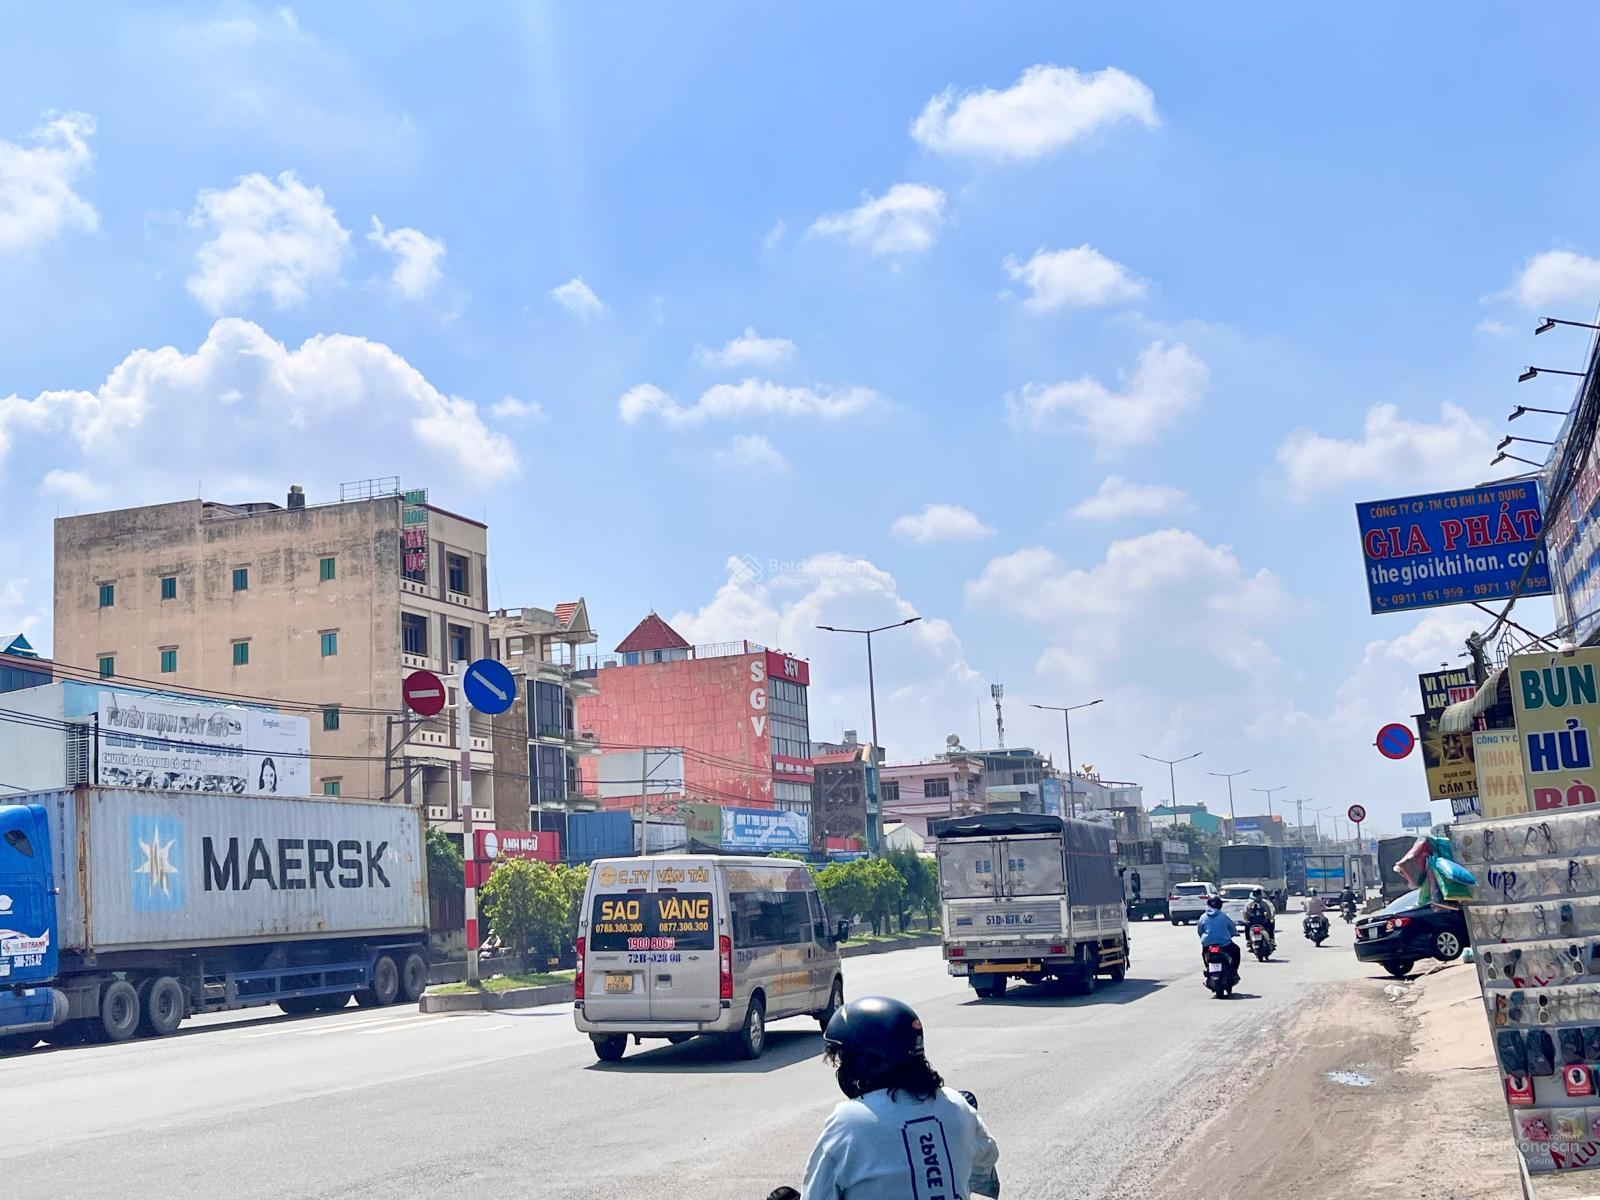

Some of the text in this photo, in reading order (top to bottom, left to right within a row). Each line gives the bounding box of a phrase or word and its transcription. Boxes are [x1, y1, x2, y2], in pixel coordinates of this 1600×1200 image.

[1399, 503, 1409, 515] TY
[1364, 523, 1432, 560] GIA
[1440, 501, 1540, 551] PHÁT
[1391, 576, 1548, 605] 0911 161 959 0971 18 959
[783, 658, 799, 678] SGV
[1423, 676, 1438, 692] VI
[1519, 657, 1598, 711] BÚN
[750, 660, 766, 737] SGV
[1501, 735, 1510, 744] TY
[1527, 718, 1592, 772] HỦ
[502, 838, 520, 851] ANH
[202, 836, 391, 891] MAERSK
[656, 866, 686, 884] VẬN
[688, 865, 709, 883] TẢI
[601, 896, 710, 920] SAO VÀNG
[627, 937, 650, 950] 1900
